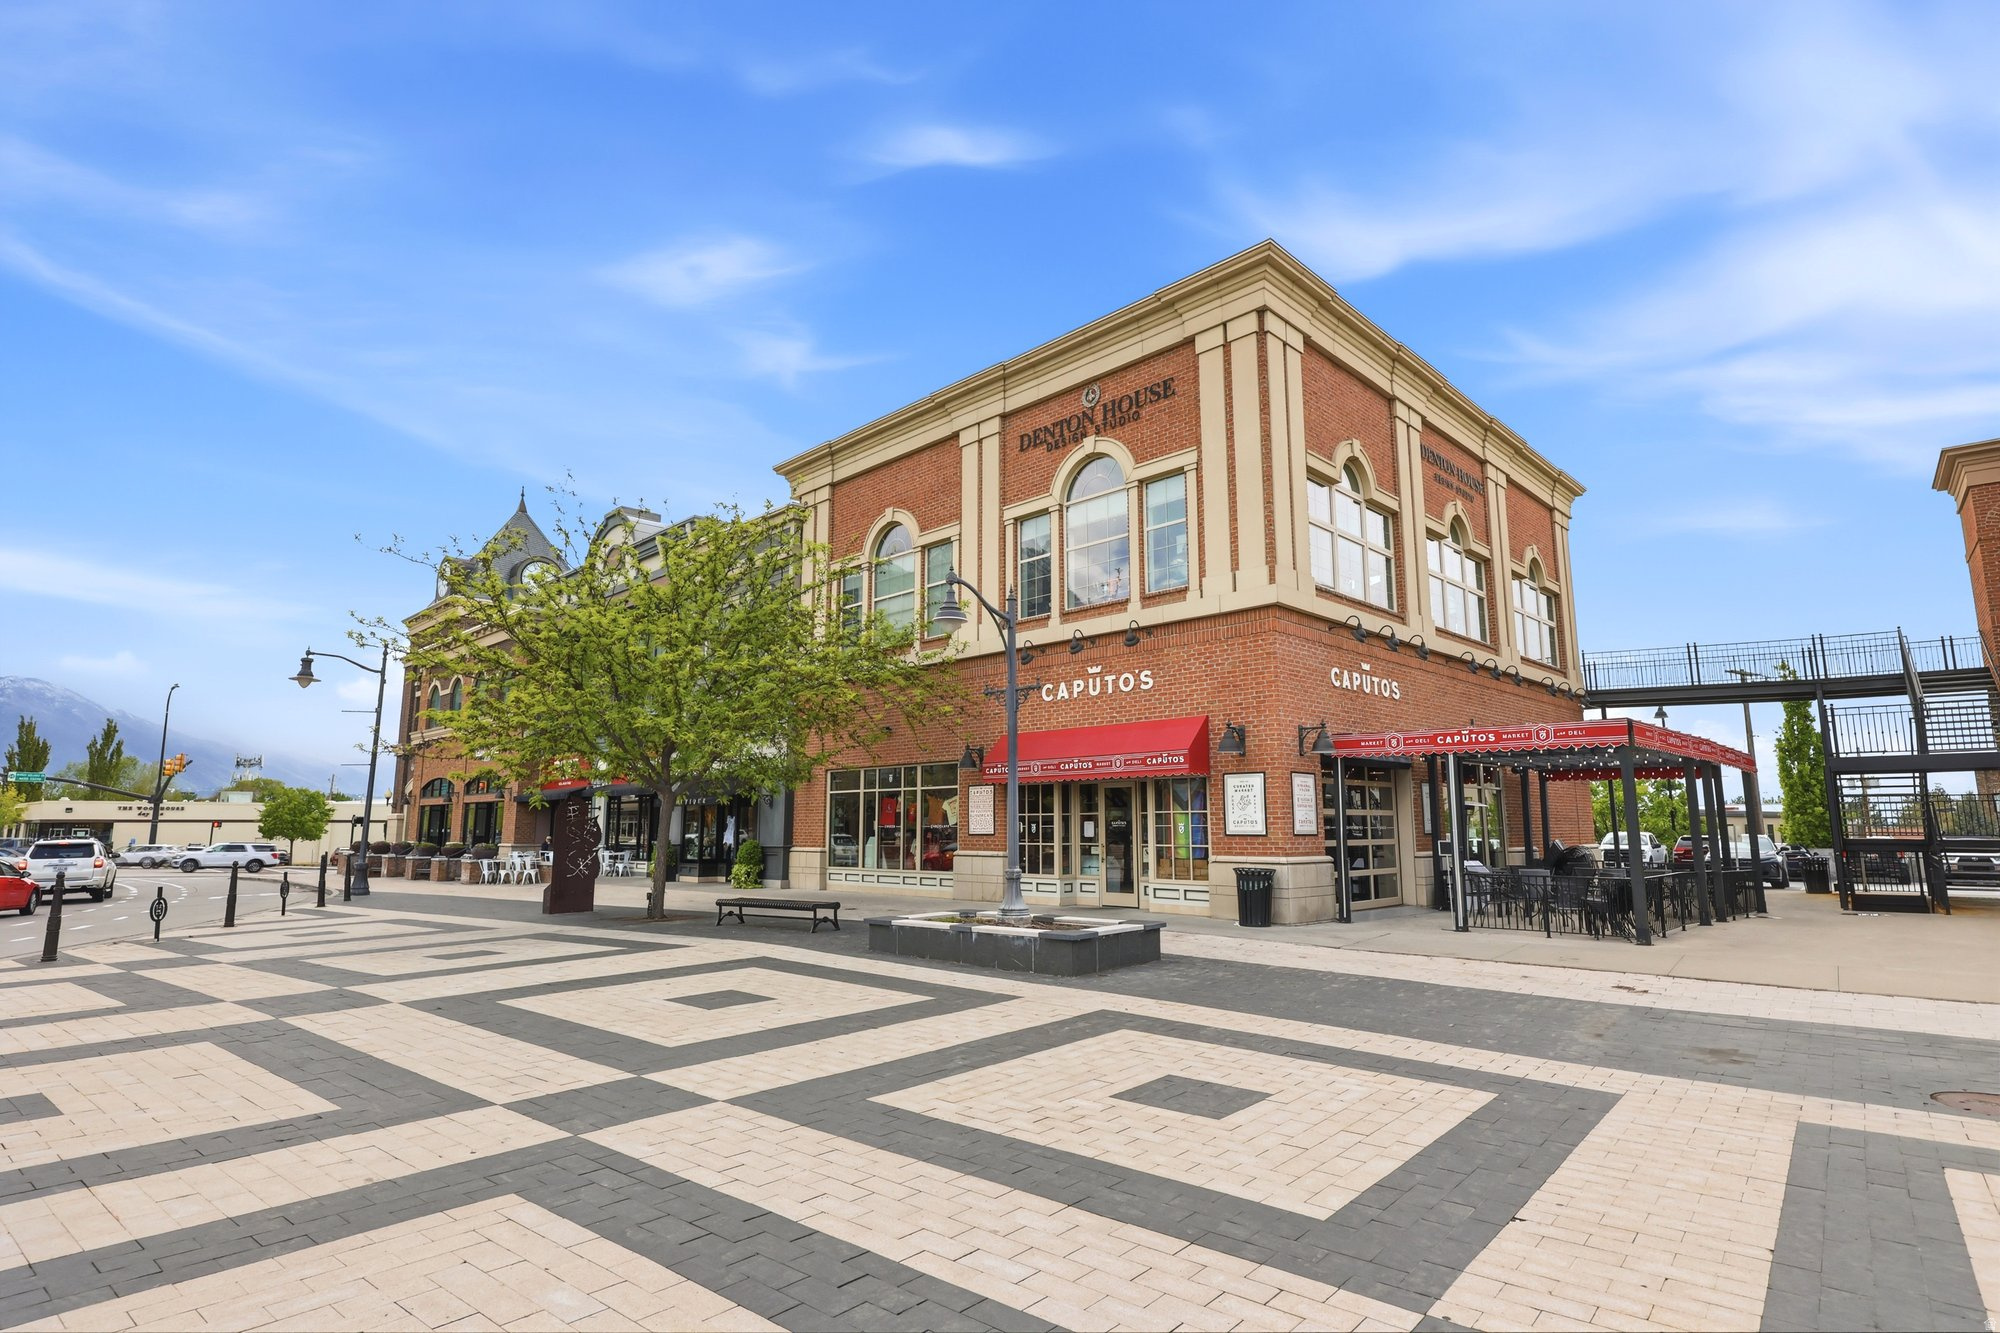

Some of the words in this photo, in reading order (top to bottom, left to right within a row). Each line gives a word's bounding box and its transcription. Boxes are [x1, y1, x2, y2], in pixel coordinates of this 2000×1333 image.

[1018, 407, 1095, 452] DENTON
[1102, 377, 1176, 421] HOUSE
[1046, 429, 1088, 452] DESIGN
[1094, 411, 1141, 434] STUDIO
[1042, 669, 1154, 701] CAPUTO'S
[1330, 667, 1401, 700] CAPUTO'S
[1437, 733, 1496, 744] CAPUTO'S
[1060, 761, 1093, 770] CAPUTO'S
[1146, 755, 1185, 765] CAPUTO'S
